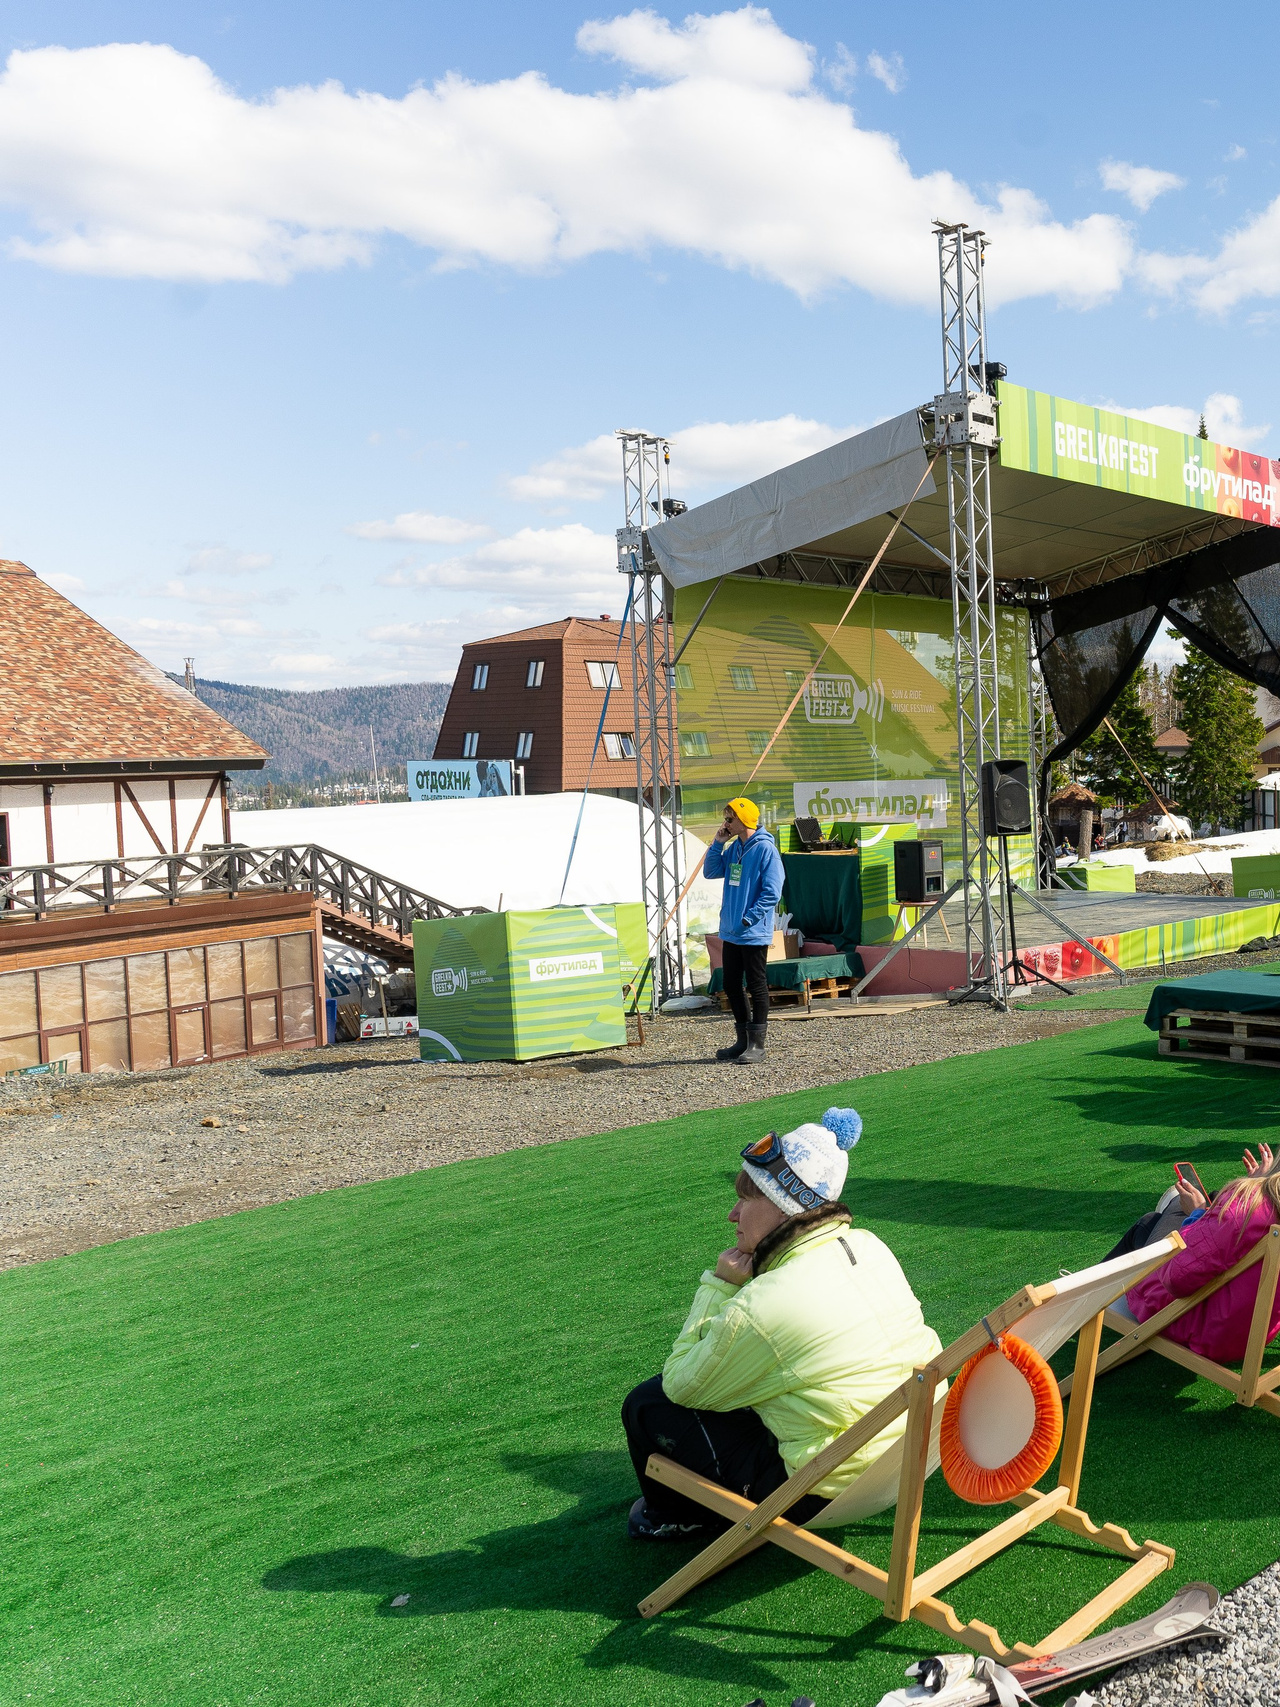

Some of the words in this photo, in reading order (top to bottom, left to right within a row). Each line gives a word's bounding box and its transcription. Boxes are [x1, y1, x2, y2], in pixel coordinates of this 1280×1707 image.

[1054, 420, 1159, 479] GRELKAFEST
[1183, 454, 1277, 510] фрутилад
[811, 680, 852, 698] GRELKA
[891, 689, 903, 699] SUN
[909, 690, 922, 700] RIDE
[812, 699, 840, 717] FEST
[891, 703, 910, 713] MUSIC
[909, 704, 936, 714] FESTIVAL
[415, 768, 471, 793] ОТДОХНИ
[807, 788, 935, 822] фрутилад
[535, 959, 598, 976] фрутилад
